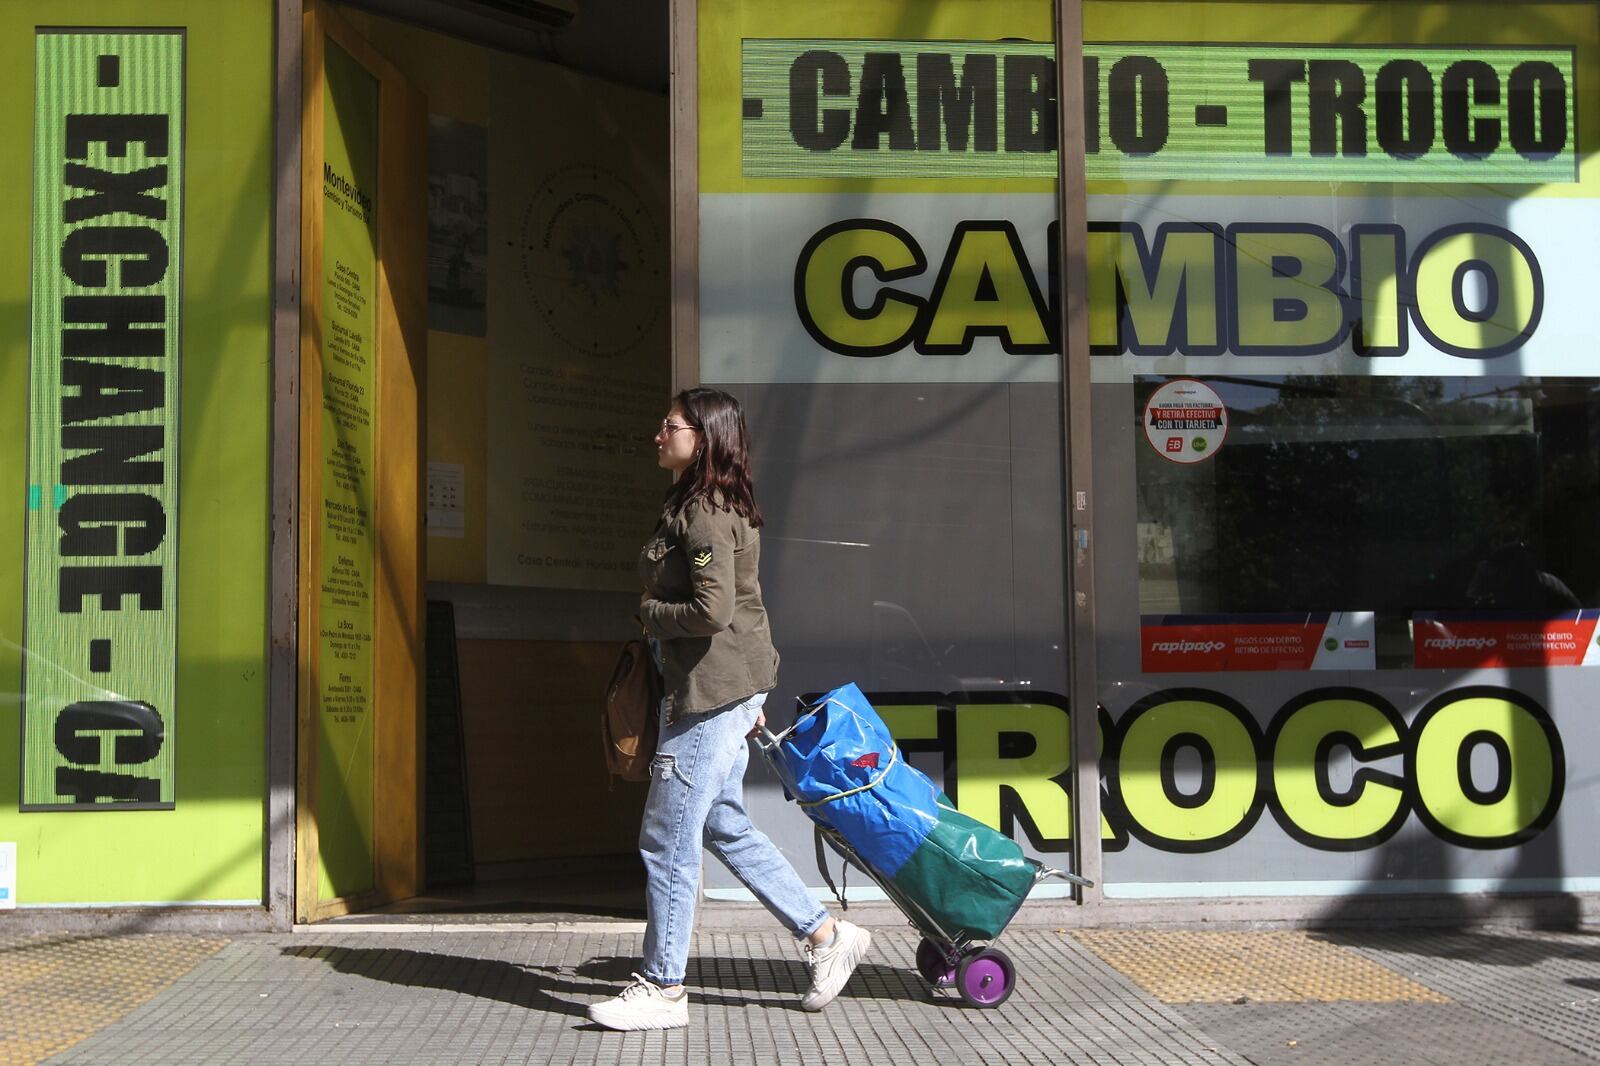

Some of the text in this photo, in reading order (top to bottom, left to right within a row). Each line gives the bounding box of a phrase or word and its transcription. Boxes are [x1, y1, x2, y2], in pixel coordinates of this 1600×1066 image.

[789, 50, 1169, 157] CAMBIO
[1247, 59, 1567, 161] TROCO
[324, 162, 371, 212] Montevideo
[794, 218, 1544, 359] CAMBIO
[58, 113, 169, 613] EXCHANGE
[1187, 410, 1216, 418] EFECTIVO
[1157, 420, 1216, 429] CON TU TARJETA
[1151, 638, 1227, 655] rapipago
[1259, 636, 1275, 644] CON
[1424, 636, 1498, 650] rapipago
